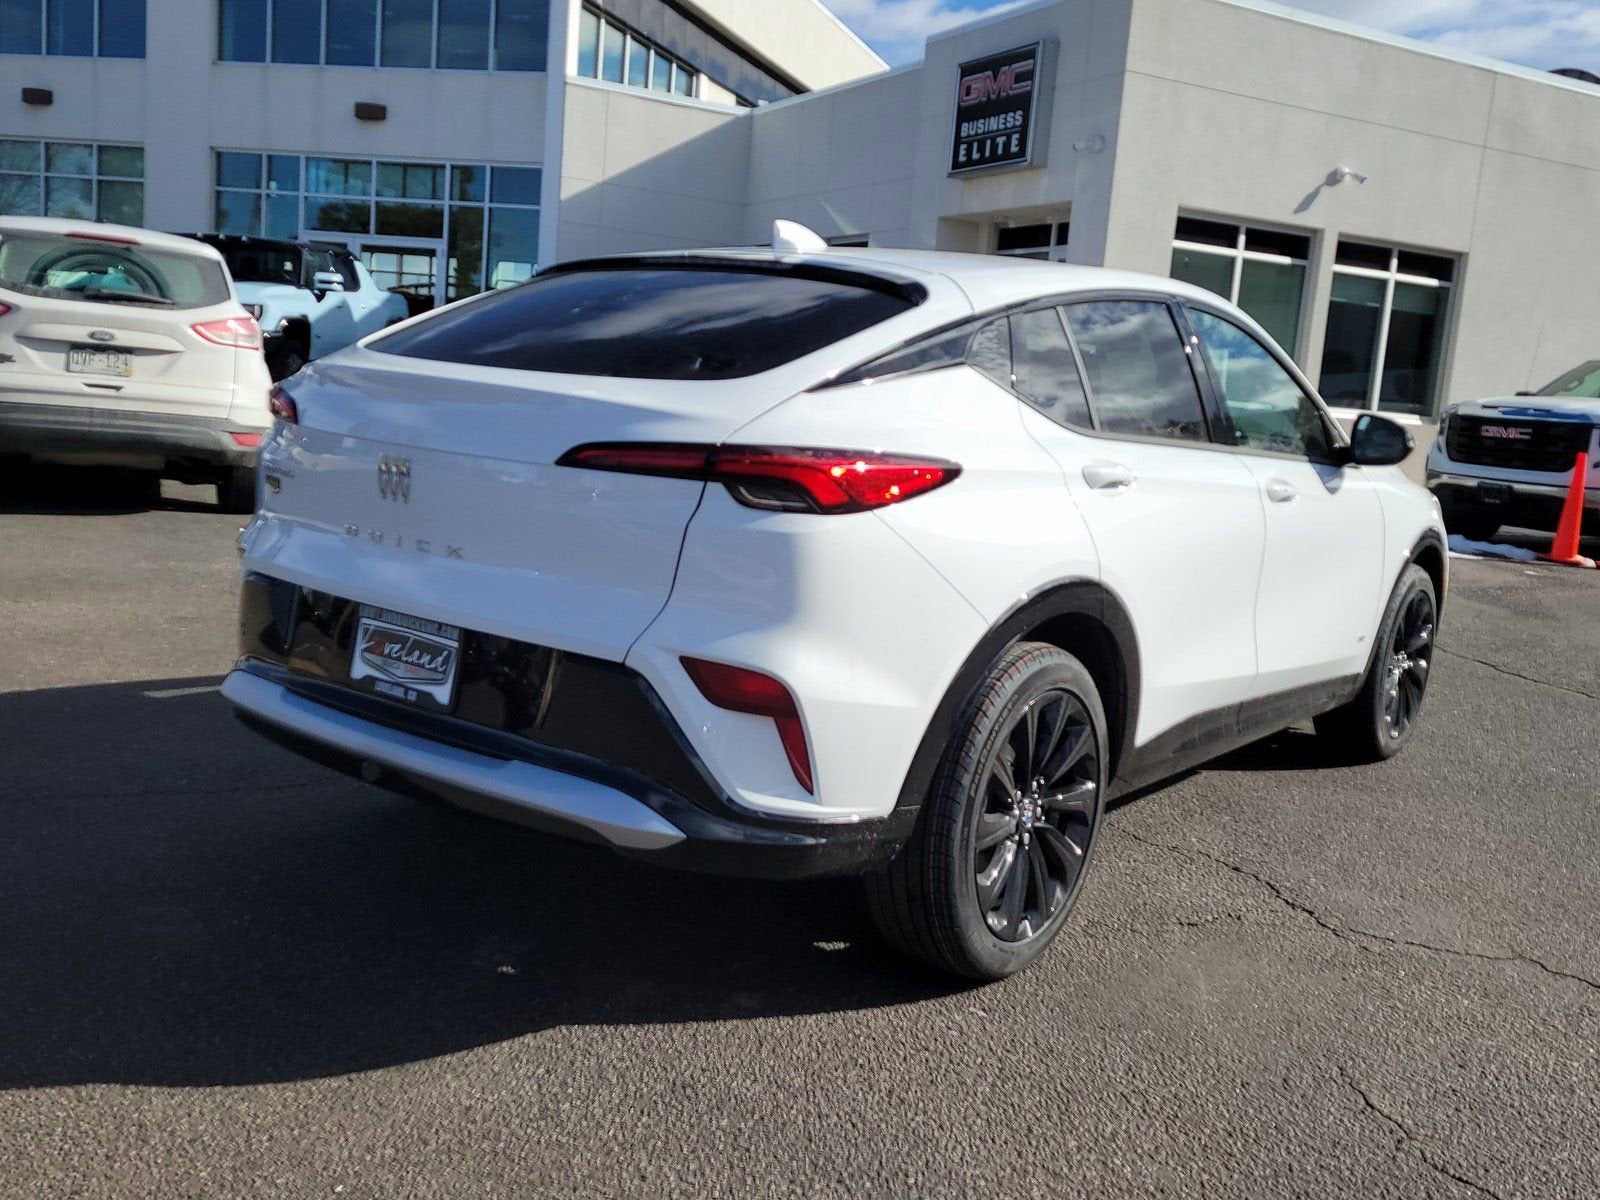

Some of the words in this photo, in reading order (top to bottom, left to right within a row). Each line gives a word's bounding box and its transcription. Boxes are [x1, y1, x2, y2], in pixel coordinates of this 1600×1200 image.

[959, 59, 1034, 106] GMC
[960, 110, 1024, 138] BUSINESS
[958, 133, 1020, 162] ELITE
[1480, 424, 1532, 440] GMC
